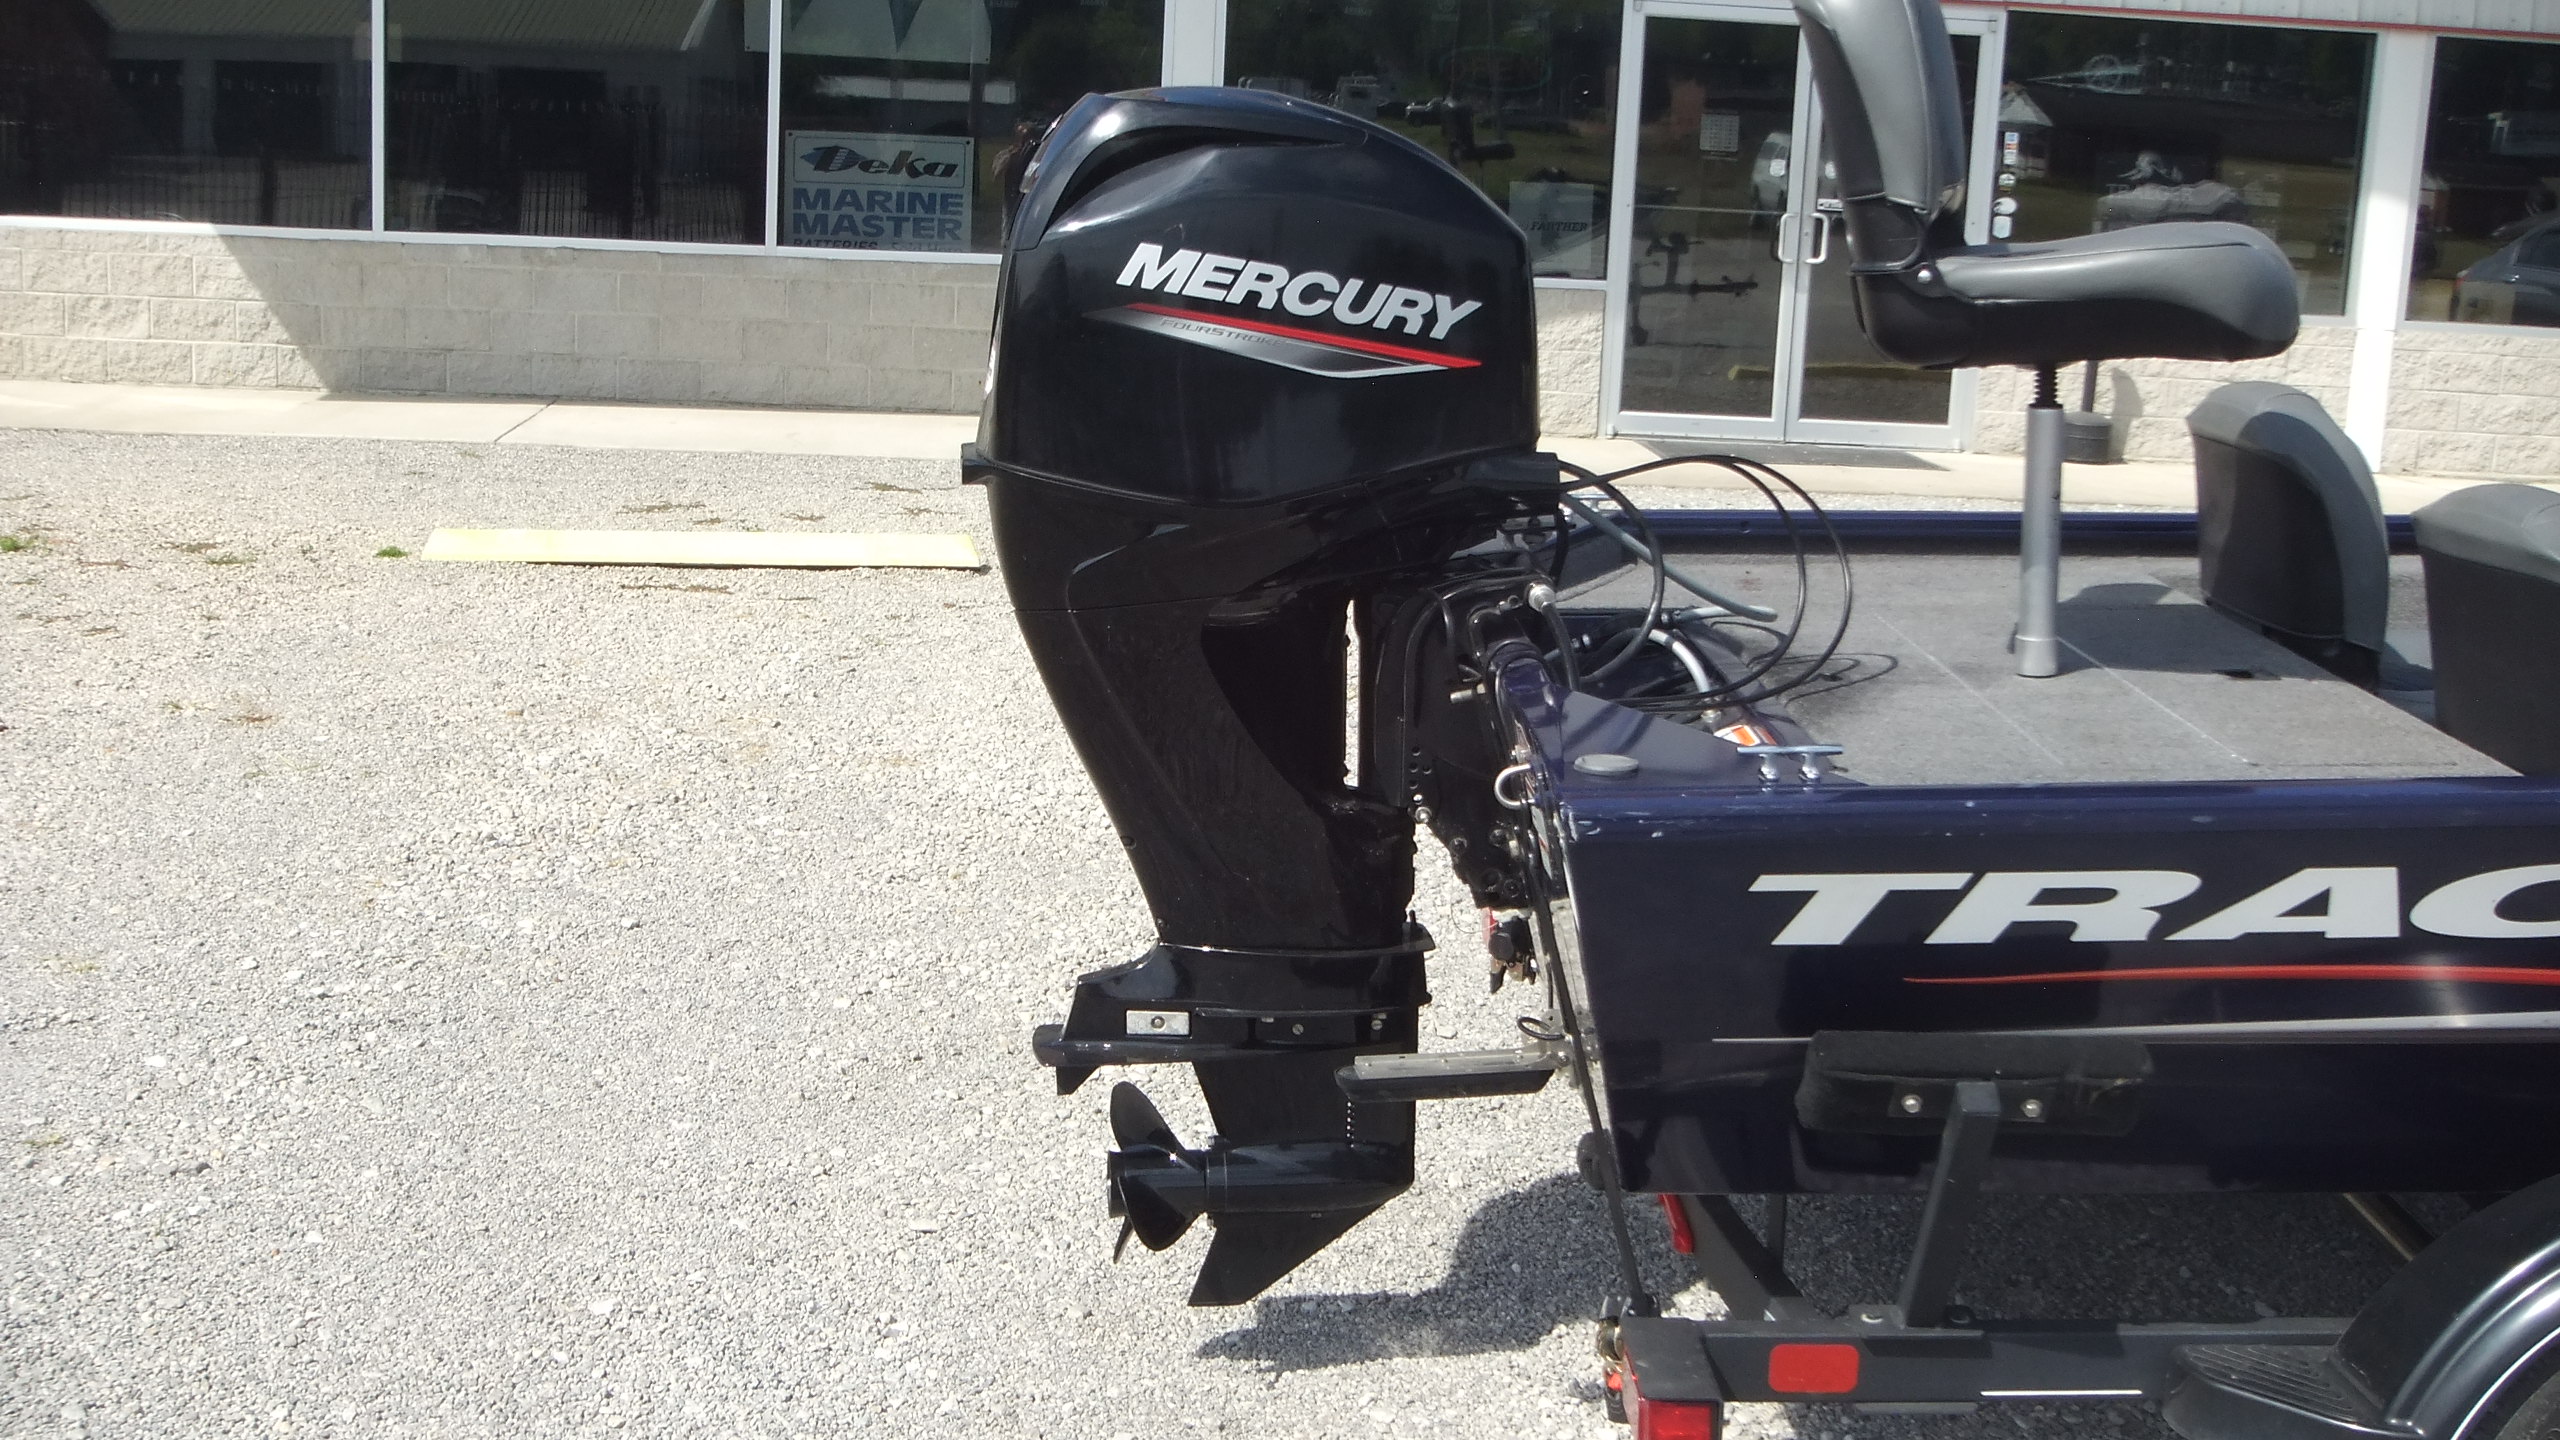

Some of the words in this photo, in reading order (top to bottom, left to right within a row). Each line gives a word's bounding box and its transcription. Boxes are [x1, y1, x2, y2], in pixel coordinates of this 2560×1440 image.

[800, 145, 959, 179] Deka
[793, 187, 964, 216] MARINE
[792, 213, 963, 241] MASTER
[1116, 242, 1483, 341] MERCURY
[1160, 318, 1283, 346] FOURSTROKE
